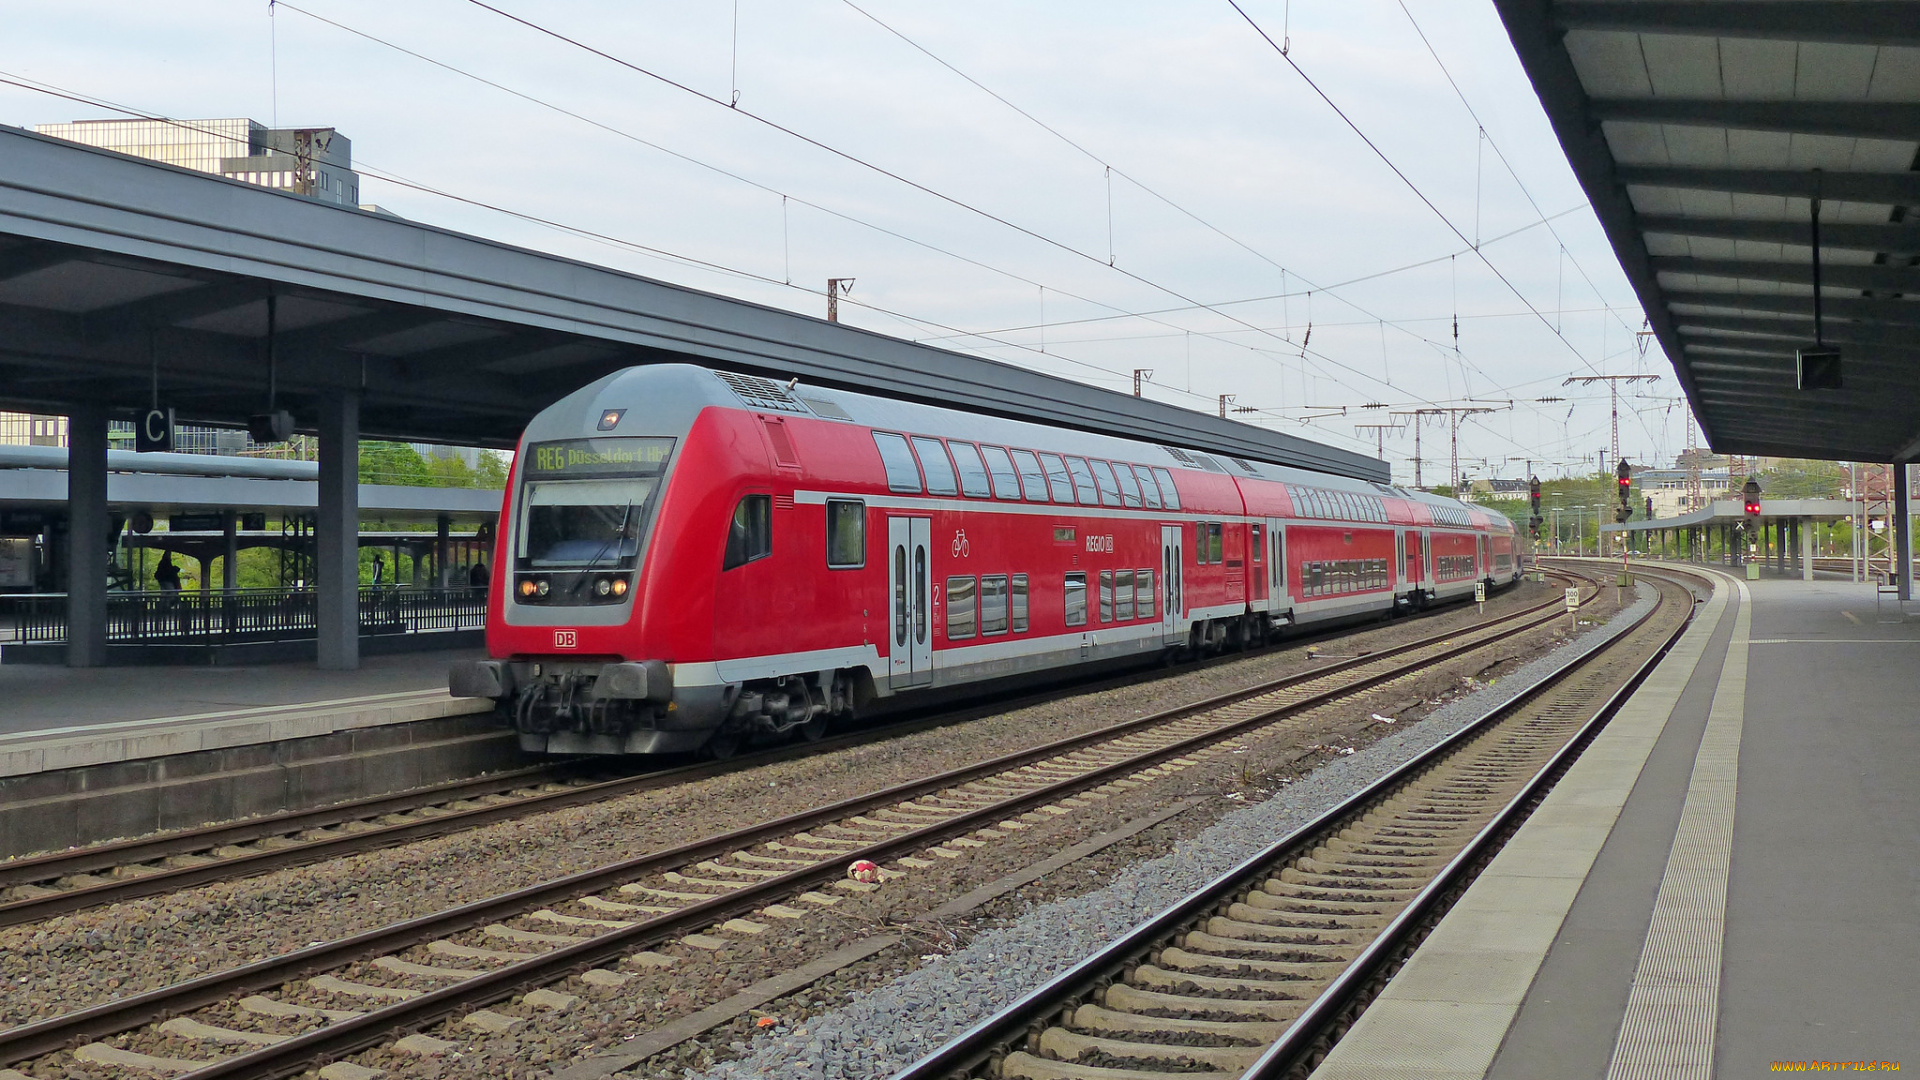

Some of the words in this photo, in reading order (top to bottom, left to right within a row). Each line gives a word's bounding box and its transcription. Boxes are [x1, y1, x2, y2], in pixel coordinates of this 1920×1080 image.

[146, 410, 164, 441] C
[537, 447, 564, 470] RE6
[568, 447, 642, 465] Düsseldorf
[1086, 535, 1105, 552] REGIO
[934, 585, 940, 606] 2
[1476, 584, 1483, 594] H
[555, 631, 576, 647] DB
